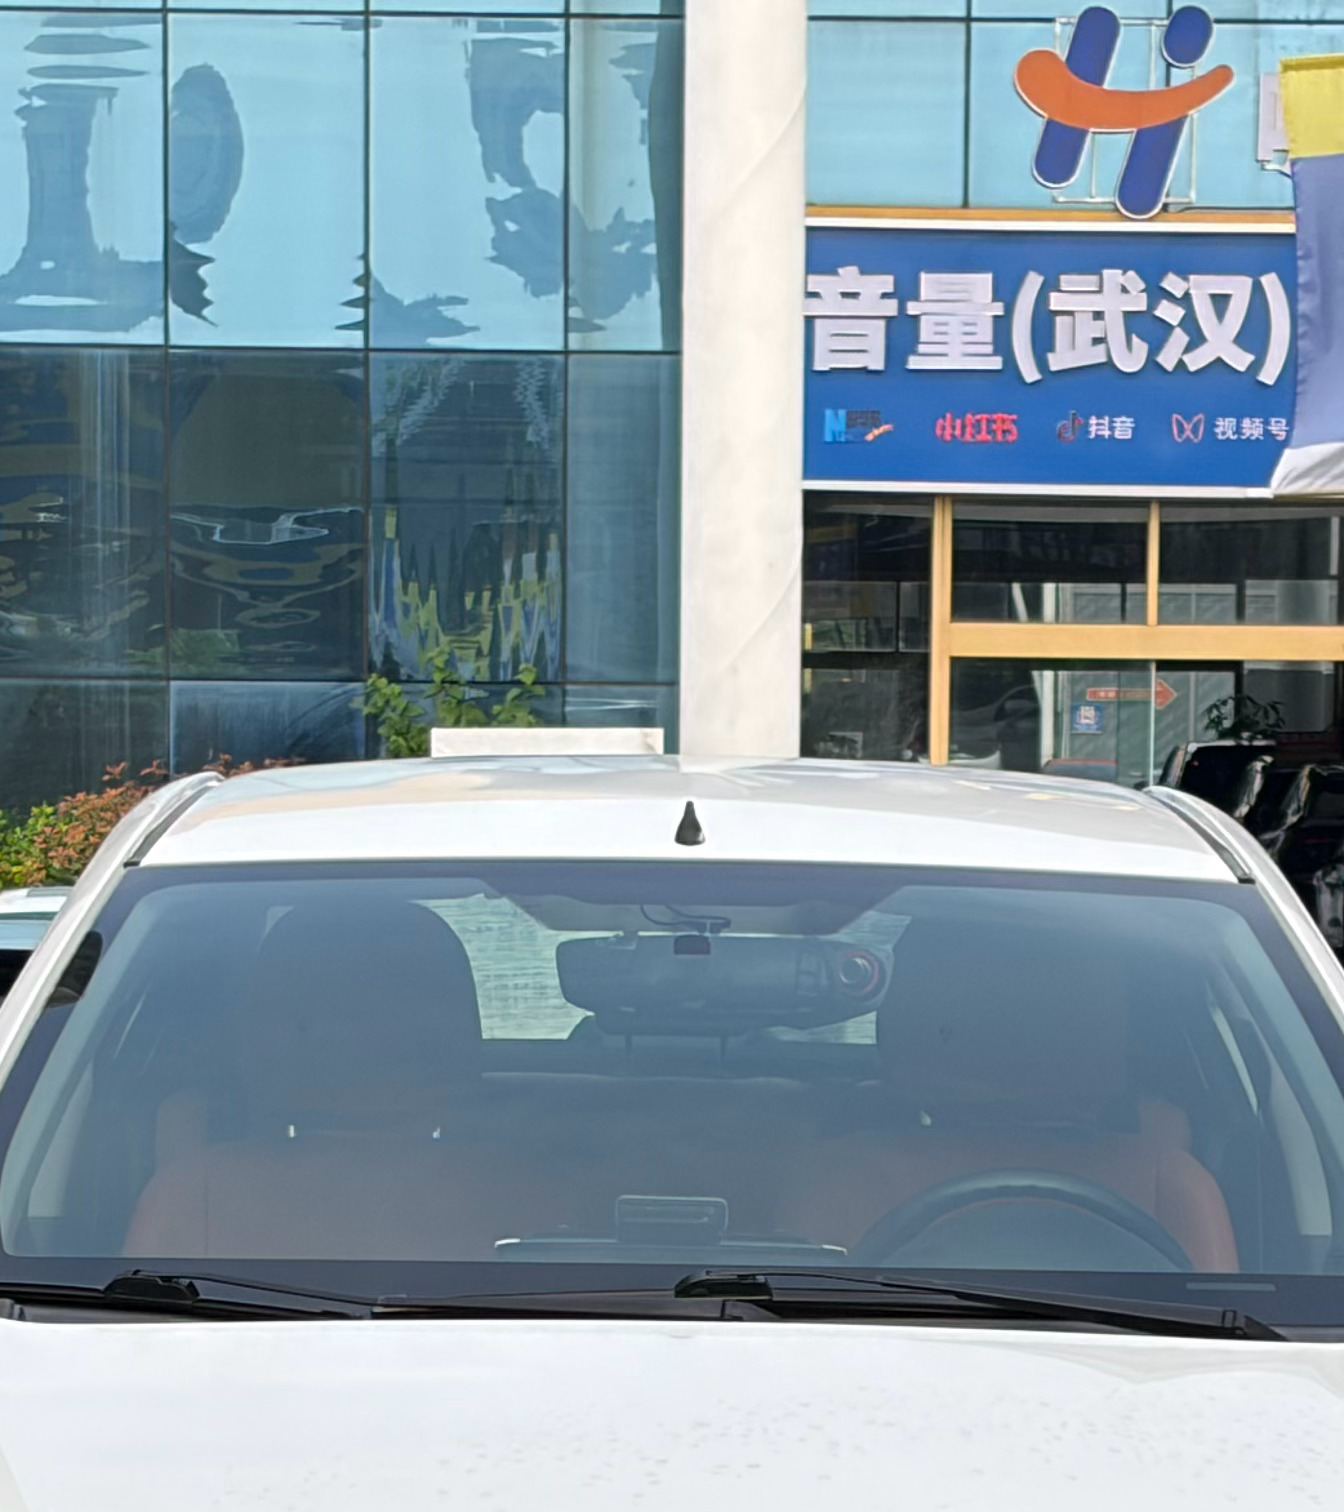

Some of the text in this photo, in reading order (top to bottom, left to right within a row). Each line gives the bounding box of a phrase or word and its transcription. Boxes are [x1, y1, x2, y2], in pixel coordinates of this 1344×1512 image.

[803, 266, 1292, 386] 音量(武汉)
[935, 412, 1018, 443] 小红书
[1087, 416, 1135, 440] 抖音
[1214, 417, 1290, 441] 视频号
